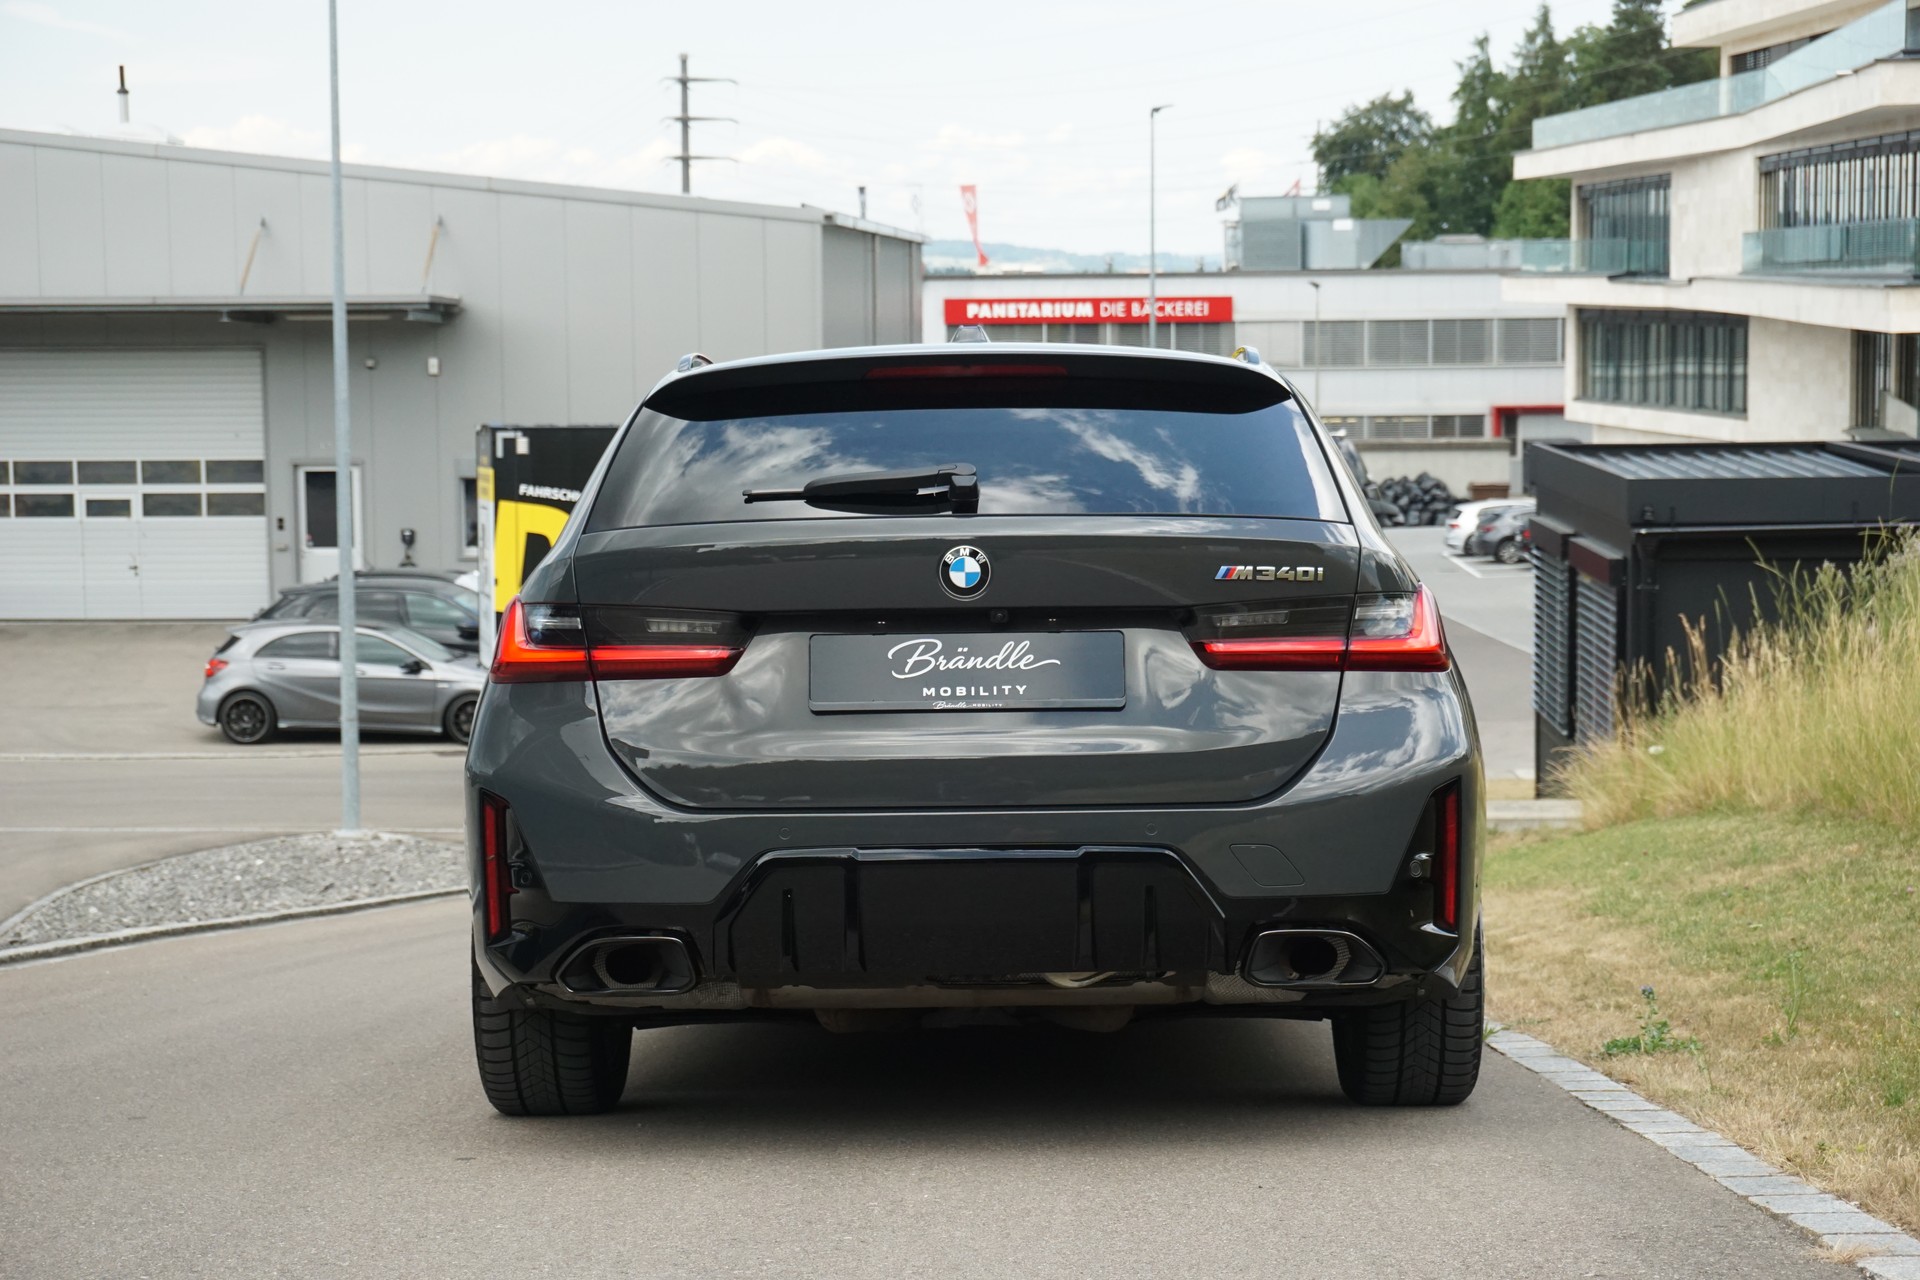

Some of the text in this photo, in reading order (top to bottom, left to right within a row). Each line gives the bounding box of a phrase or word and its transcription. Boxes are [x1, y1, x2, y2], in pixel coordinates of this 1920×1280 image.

[1100, 301, 1127, 318] DIE
[1131, 298, 1210, 318] BÄCKEREI
[518, 483, 582, 502] FAHRSCH
[944, 547, 986, 565] BMW
[1215, 565, 1324, 581] M340i
[887, 638, 1061, 679] Brändle
[922, 684, 1027, 697] MOBILITY
[932, 700, 972, 710] Brändle
